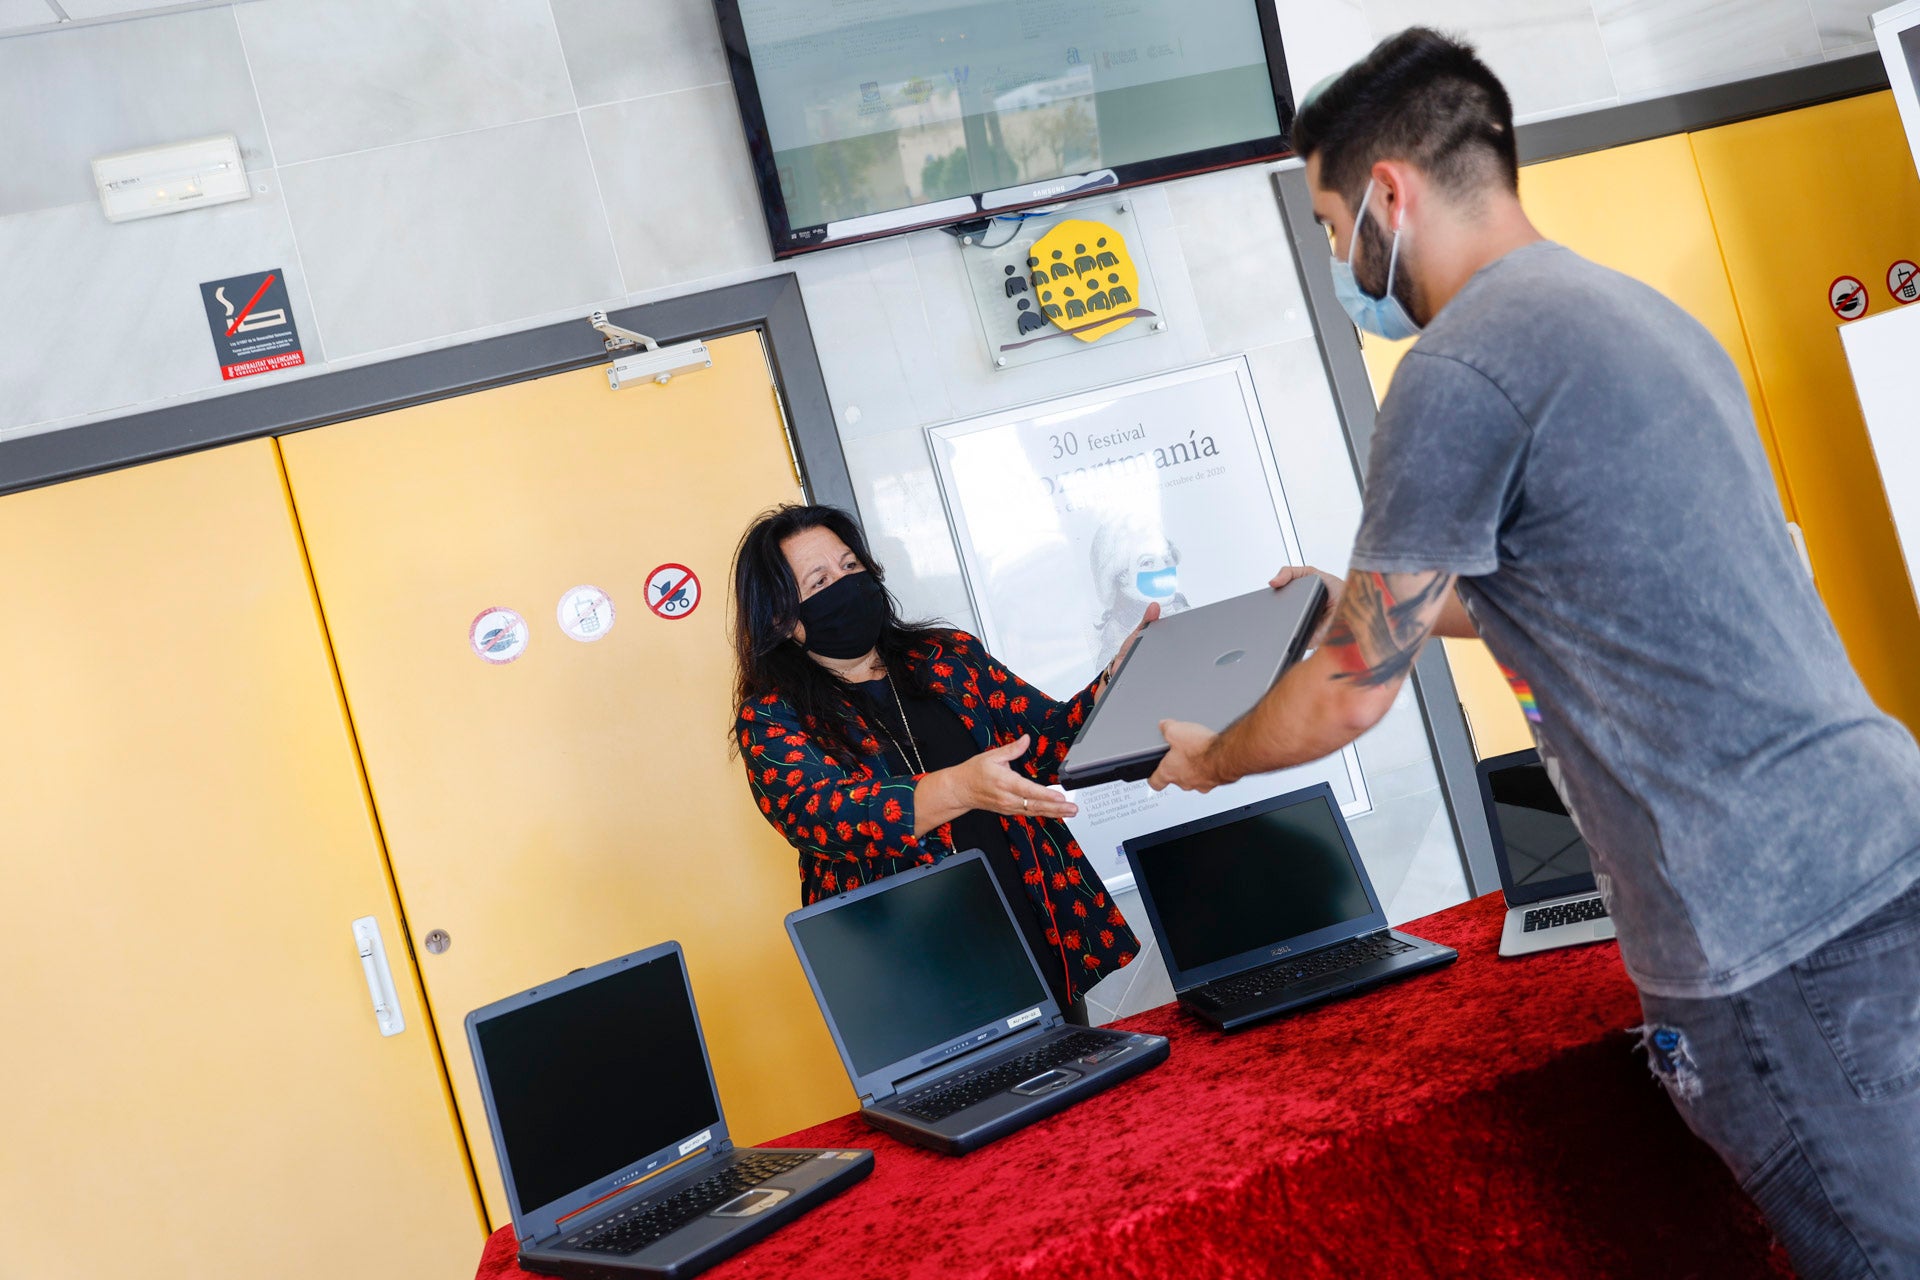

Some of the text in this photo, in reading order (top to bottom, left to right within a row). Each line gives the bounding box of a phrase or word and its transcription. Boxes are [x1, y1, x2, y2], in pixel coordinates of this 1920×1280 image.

[1033, 185, 1065, 198] SAMSUNG
[234, 353, 300, 372] GENERALITAT VALENCIANA
[1049, 423, 1146, 459] 30 festival
[1164, 474, 1193, 489] octubre
[1195, 471, 1205, 482] de
[1207, 466, 1226, 478] 2020
